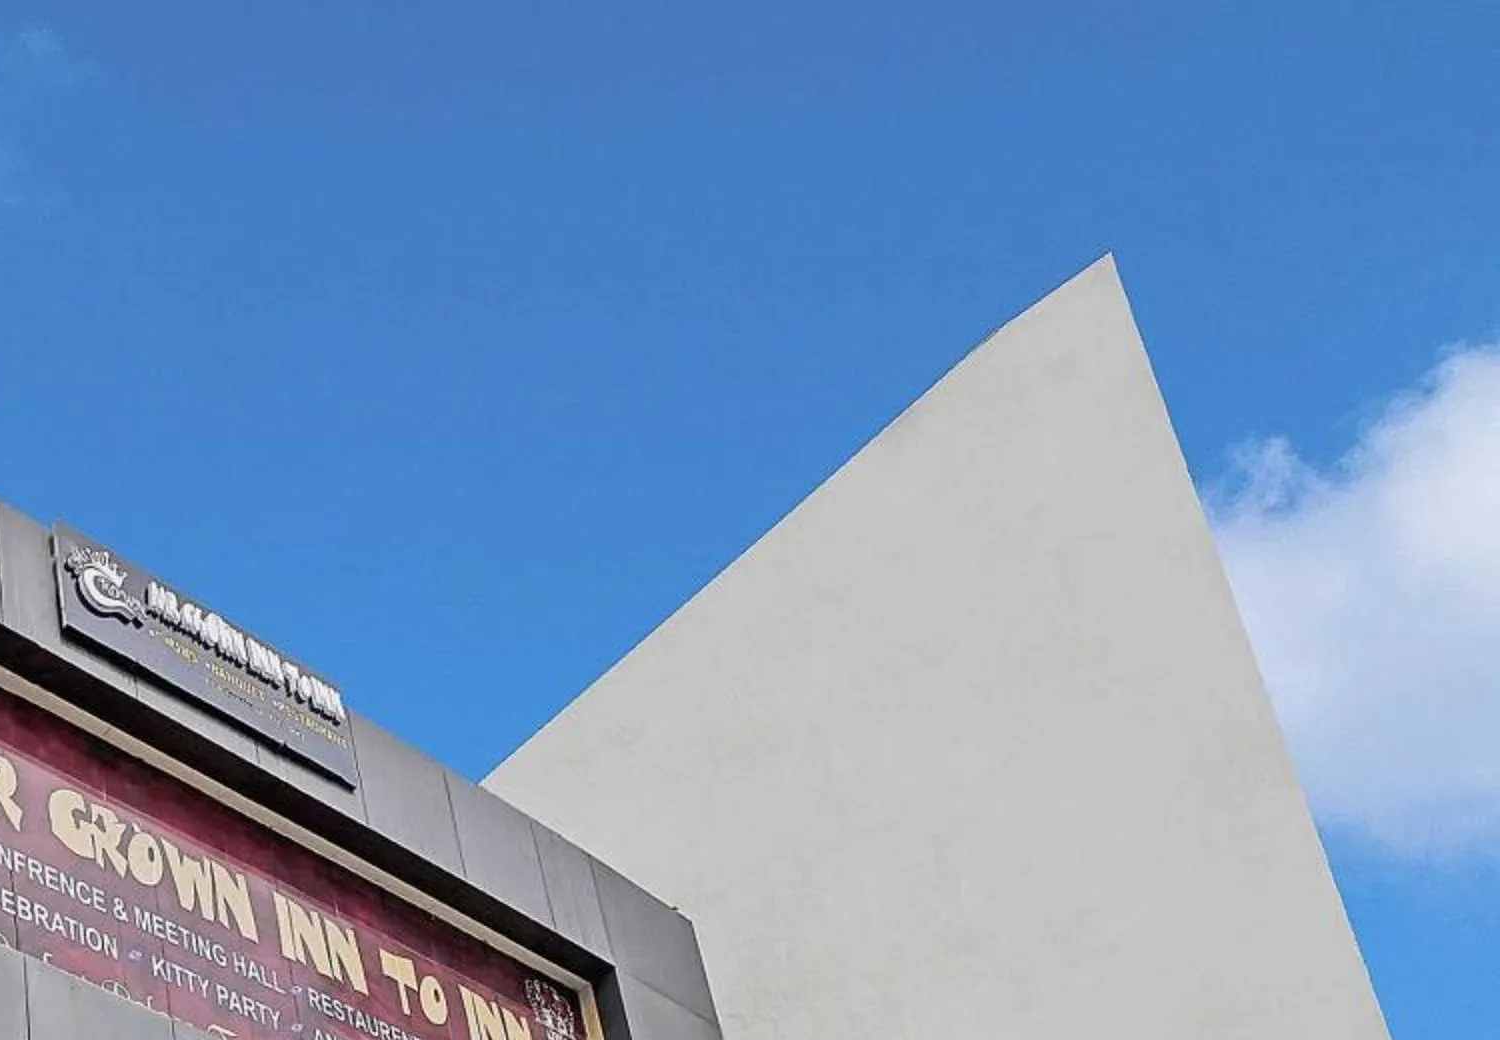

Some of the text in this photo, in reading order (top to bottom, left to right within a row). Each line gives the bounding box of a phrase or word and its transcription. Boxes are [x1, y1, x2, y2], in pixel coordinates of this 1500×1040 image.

[48, 788, 260, 945] CROWN
[273, 890, 369, 996] INN
[379, 948, 449, 1026] TO
[112, 896, 130, 924] &
[134, 905, 228, 968] MEETING
[233, 954, 286, 995] HALL
[151, 955, 212, 999] KITTY
[216, 984, 281, 1031] PARTY
